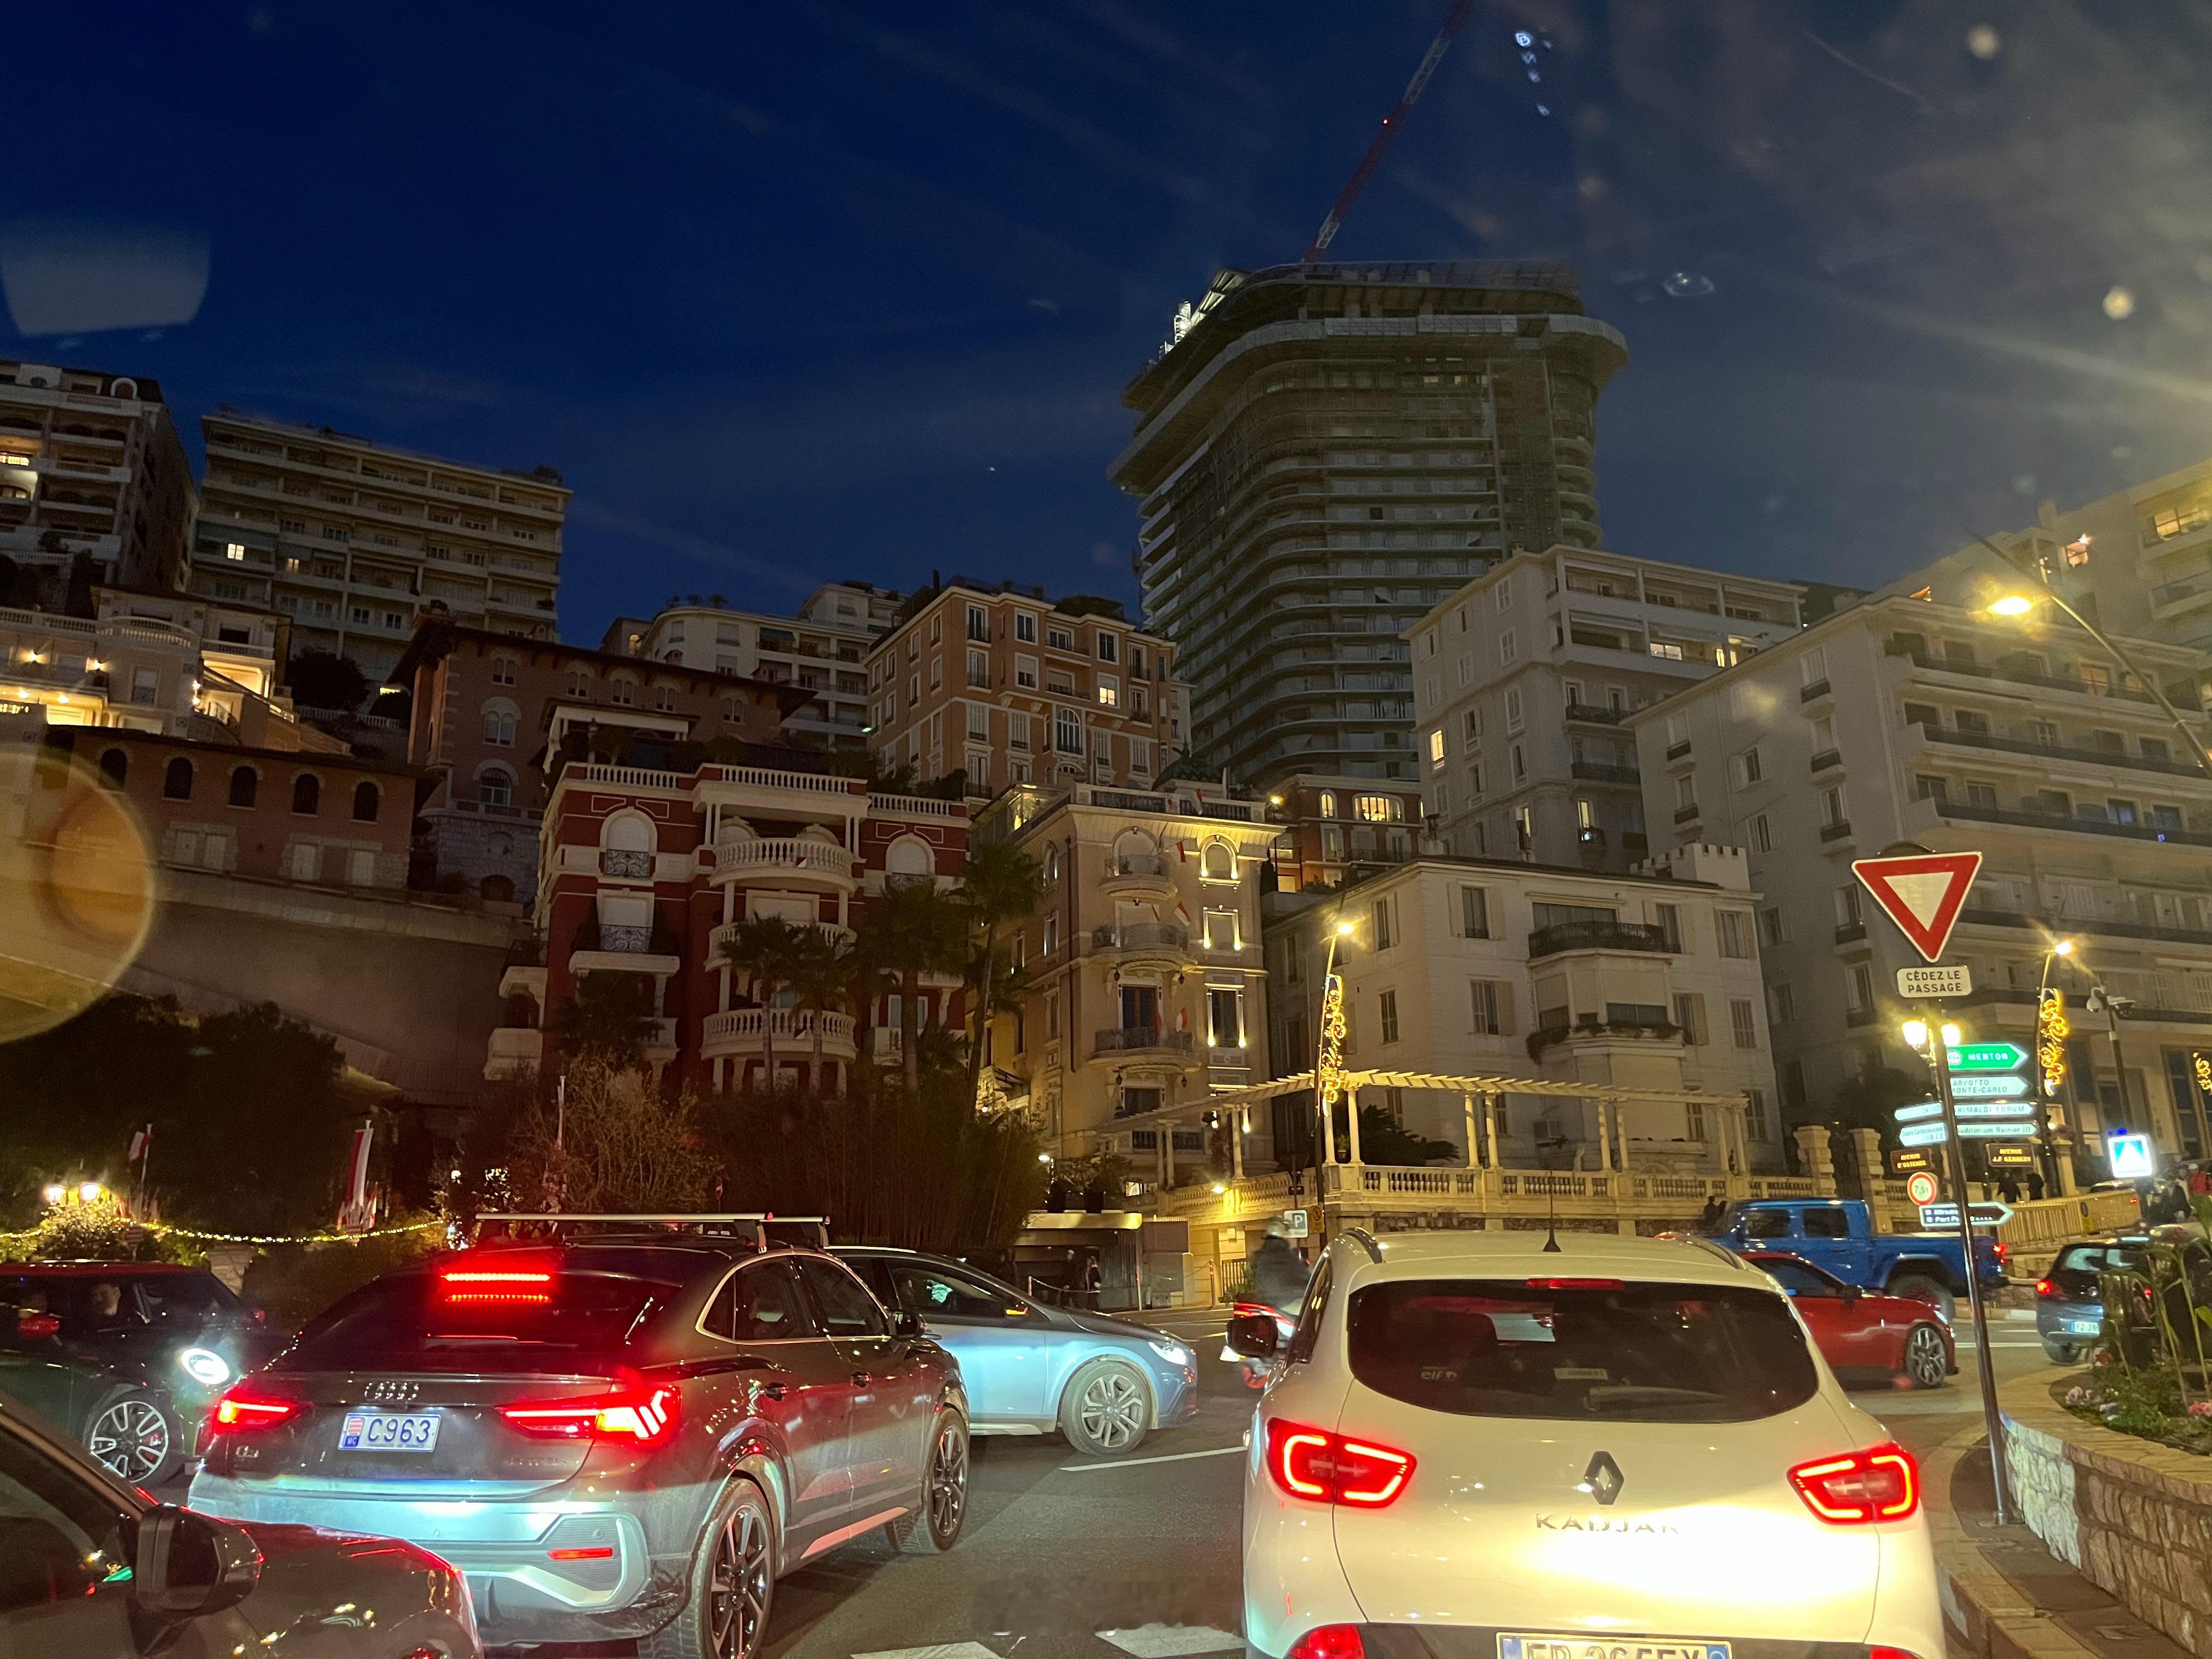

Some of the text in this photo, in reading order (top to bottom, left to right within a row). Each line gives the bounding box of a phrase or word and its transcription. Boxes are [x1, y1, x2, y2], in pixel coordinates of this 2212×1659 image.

[1906, 970, 1960, 981] CÉDEZ LE
[1908, 983, 1962, 993] PASSAGE
[1294, 1215, 1303, 1228] P
[367, 1418, 431, 1443] C963
